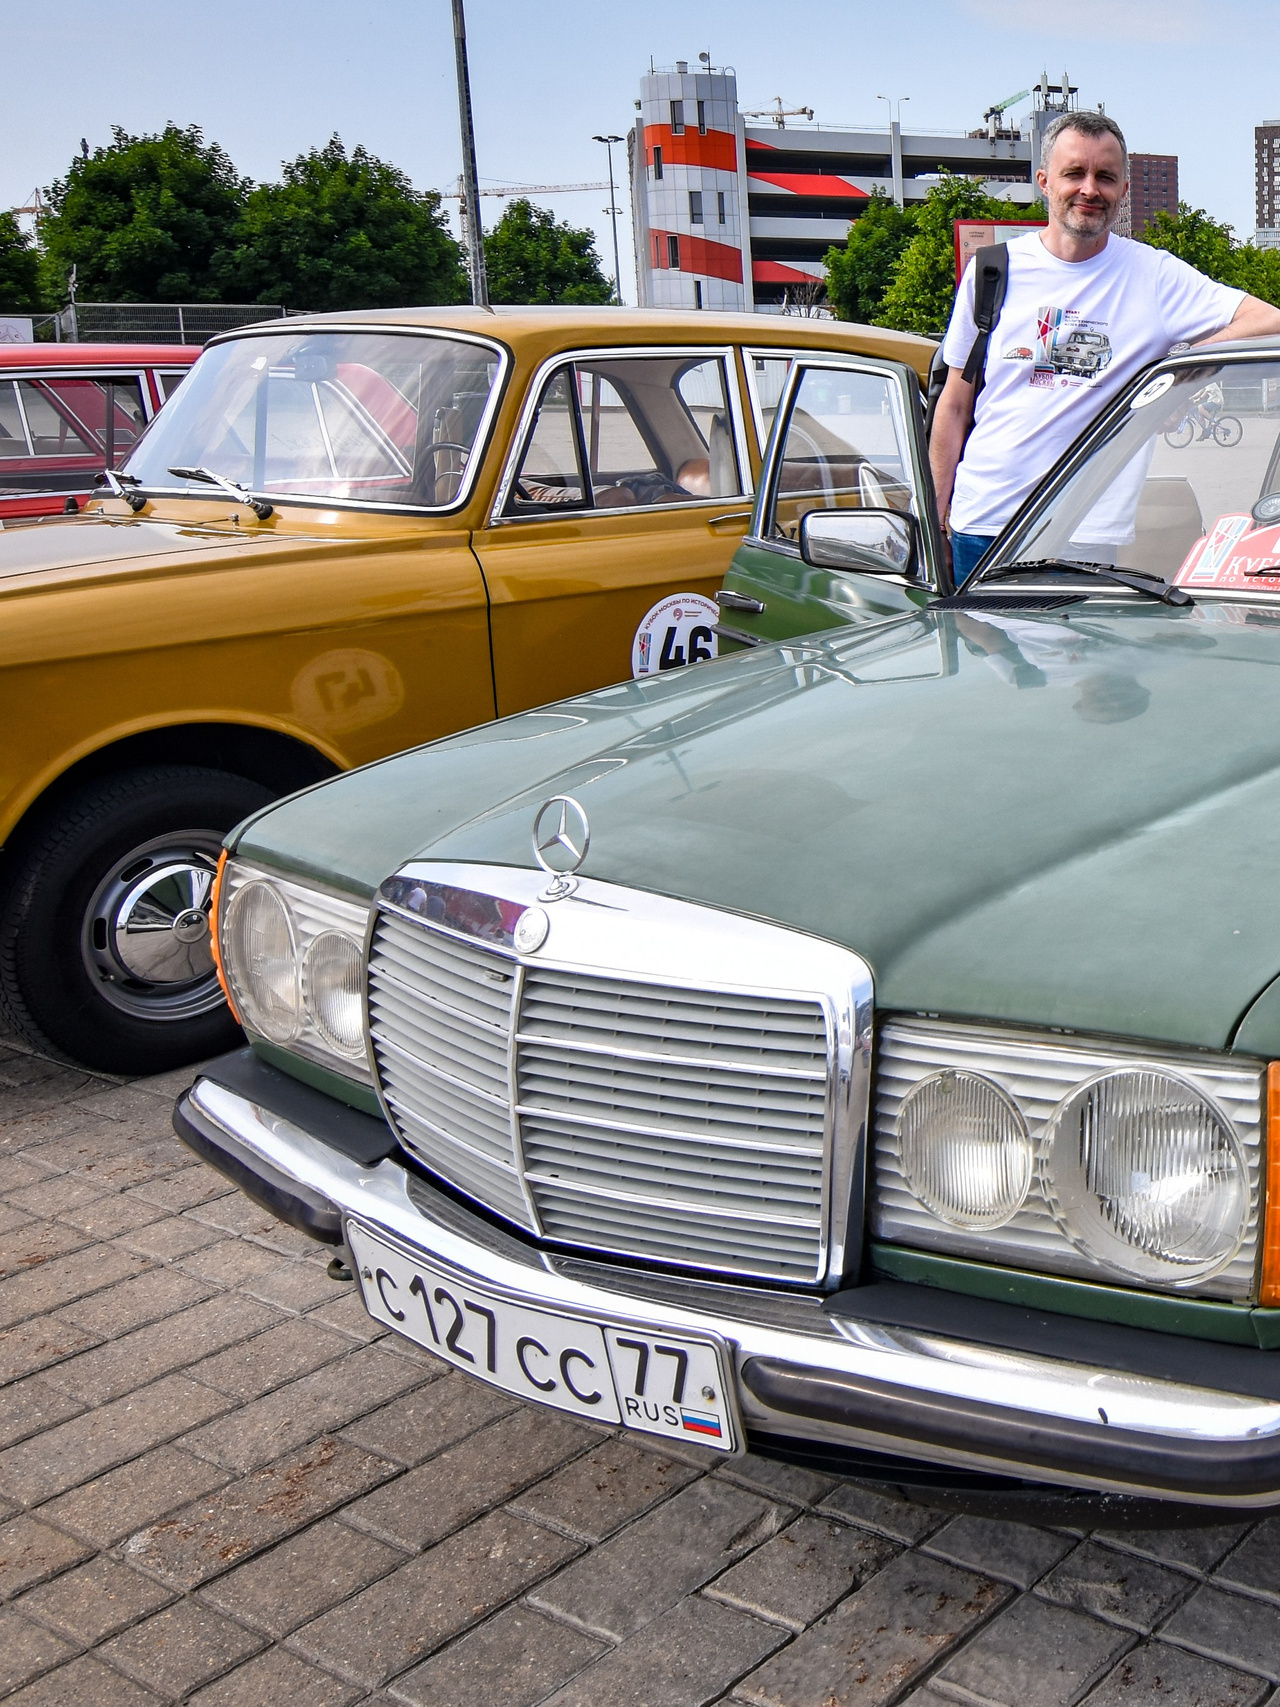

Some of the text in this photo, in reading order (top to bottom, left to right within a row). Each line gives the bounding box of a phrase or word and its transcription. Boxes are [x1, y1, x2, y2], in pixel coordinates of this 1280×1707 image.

[1143, 382, 1166, 398] 47
[645, 612, 660, 630] КУБОК
[658, 599, 681, 614] МОСКВЫ
[659, 626, 712, 670] 46
[616, 1337, 688, 1403] 77
[625, 1396, 678, 1426] RUS
